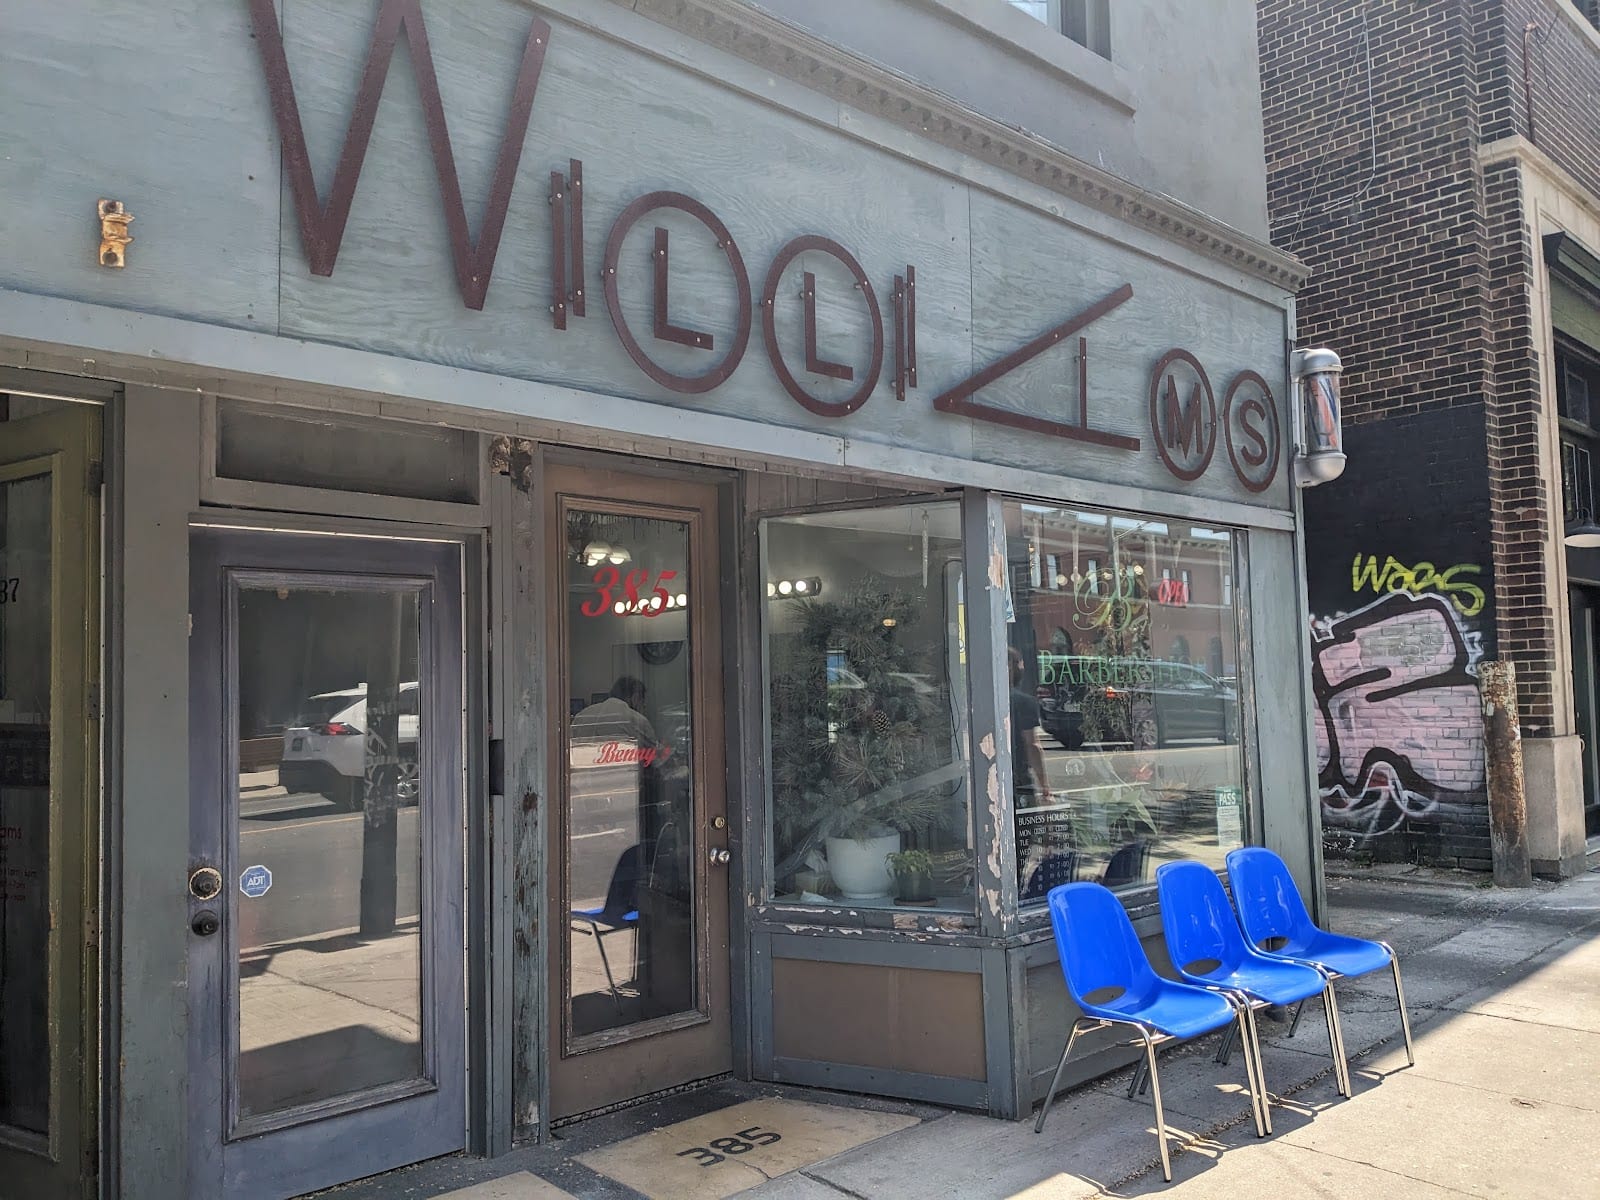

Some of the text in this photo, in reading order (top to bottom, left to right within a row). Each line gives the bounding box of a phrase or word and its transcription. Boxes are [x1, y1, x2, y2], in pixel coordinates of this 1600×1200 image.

[581, 566, 677, 617] 385
[1219, 793, 1236, 806] PASS
[1018, 812, 1069, 826] BUSINESS HOURS
[1019, 829, 1032, 837] MON
[1020, 848, 1031, 856] WED
[247, 875, 265, 887] ADT
[676, 1126, 782, 1167] 385
